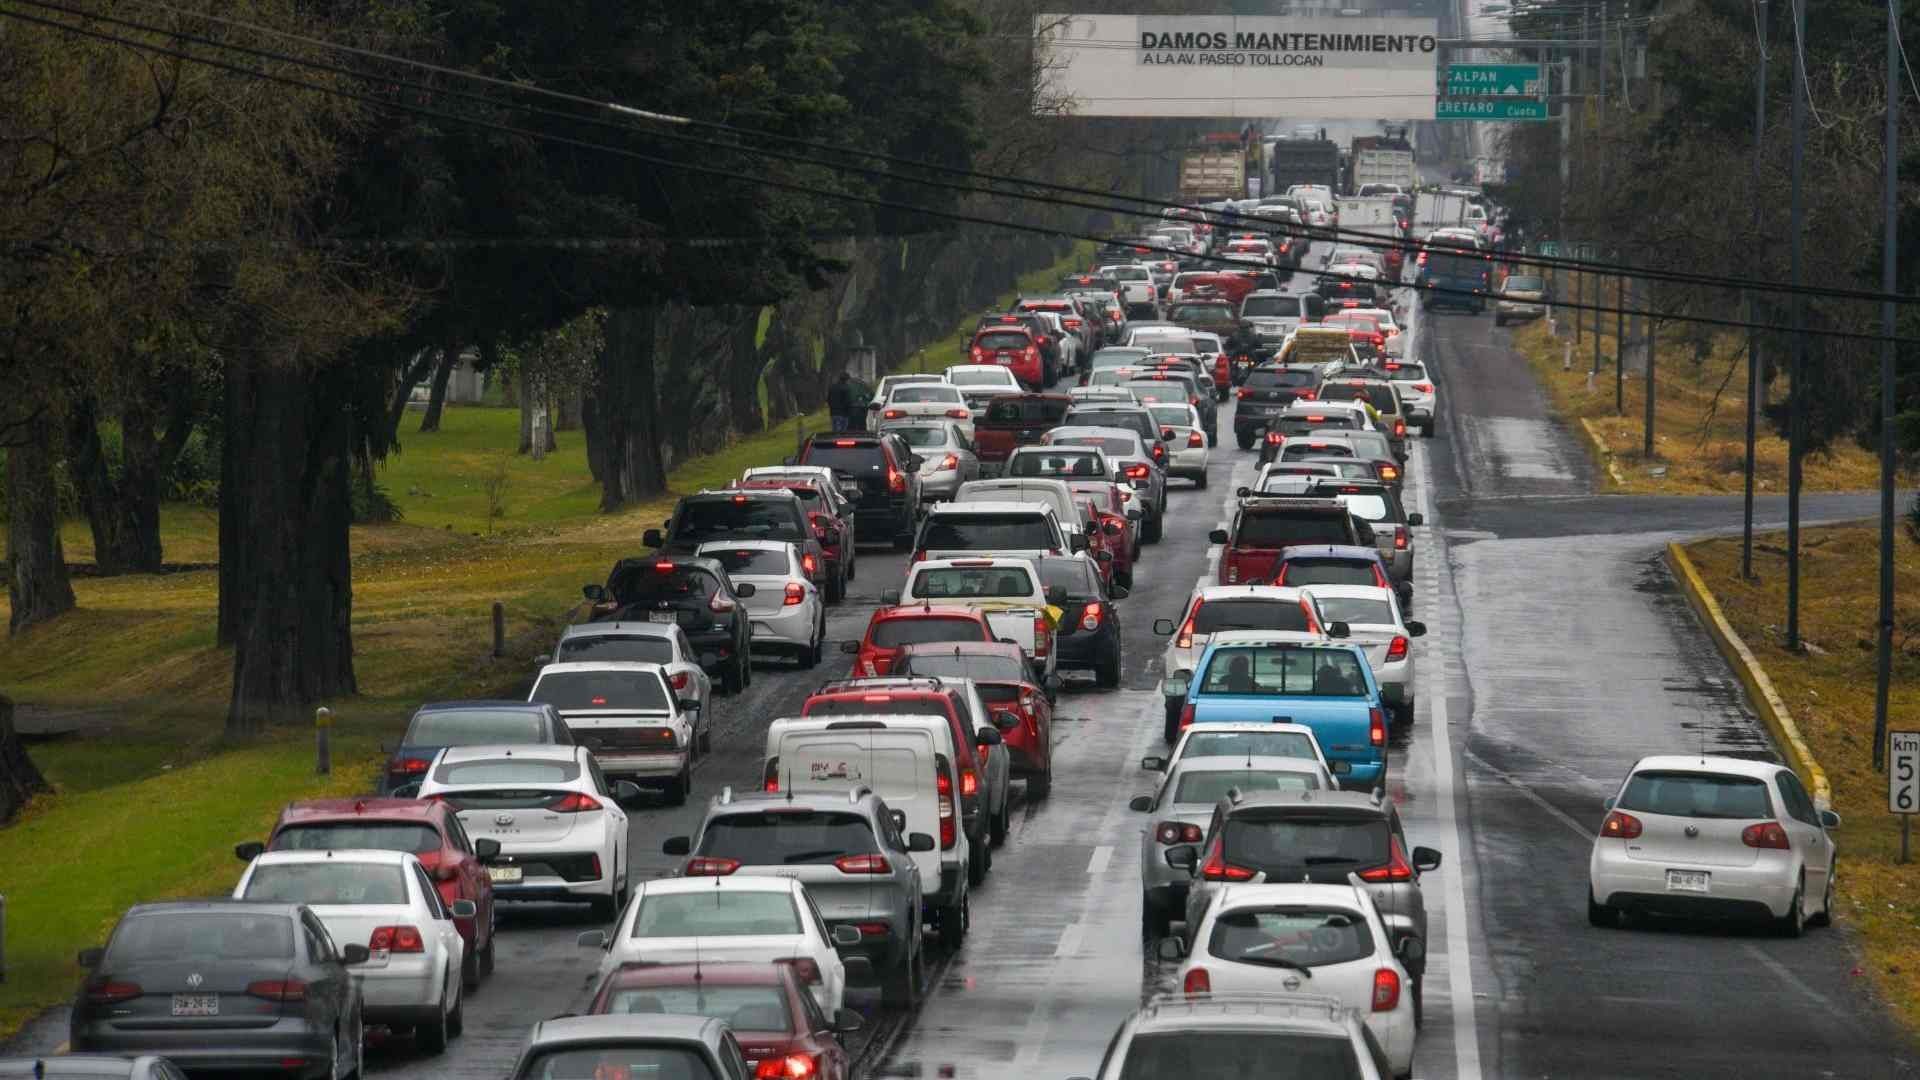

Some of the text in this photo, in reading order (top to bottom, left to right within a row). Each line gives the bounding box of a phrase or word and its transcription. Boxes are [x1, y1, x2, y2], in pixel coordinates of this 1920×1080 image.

[1142, 32, 1436, 52] DAMOS MANTENIMIENTO
[1143, 53, 1323, 66] A LA AV. PASEO TOLLOCAN
[1893, 737, 1918, 752] km
